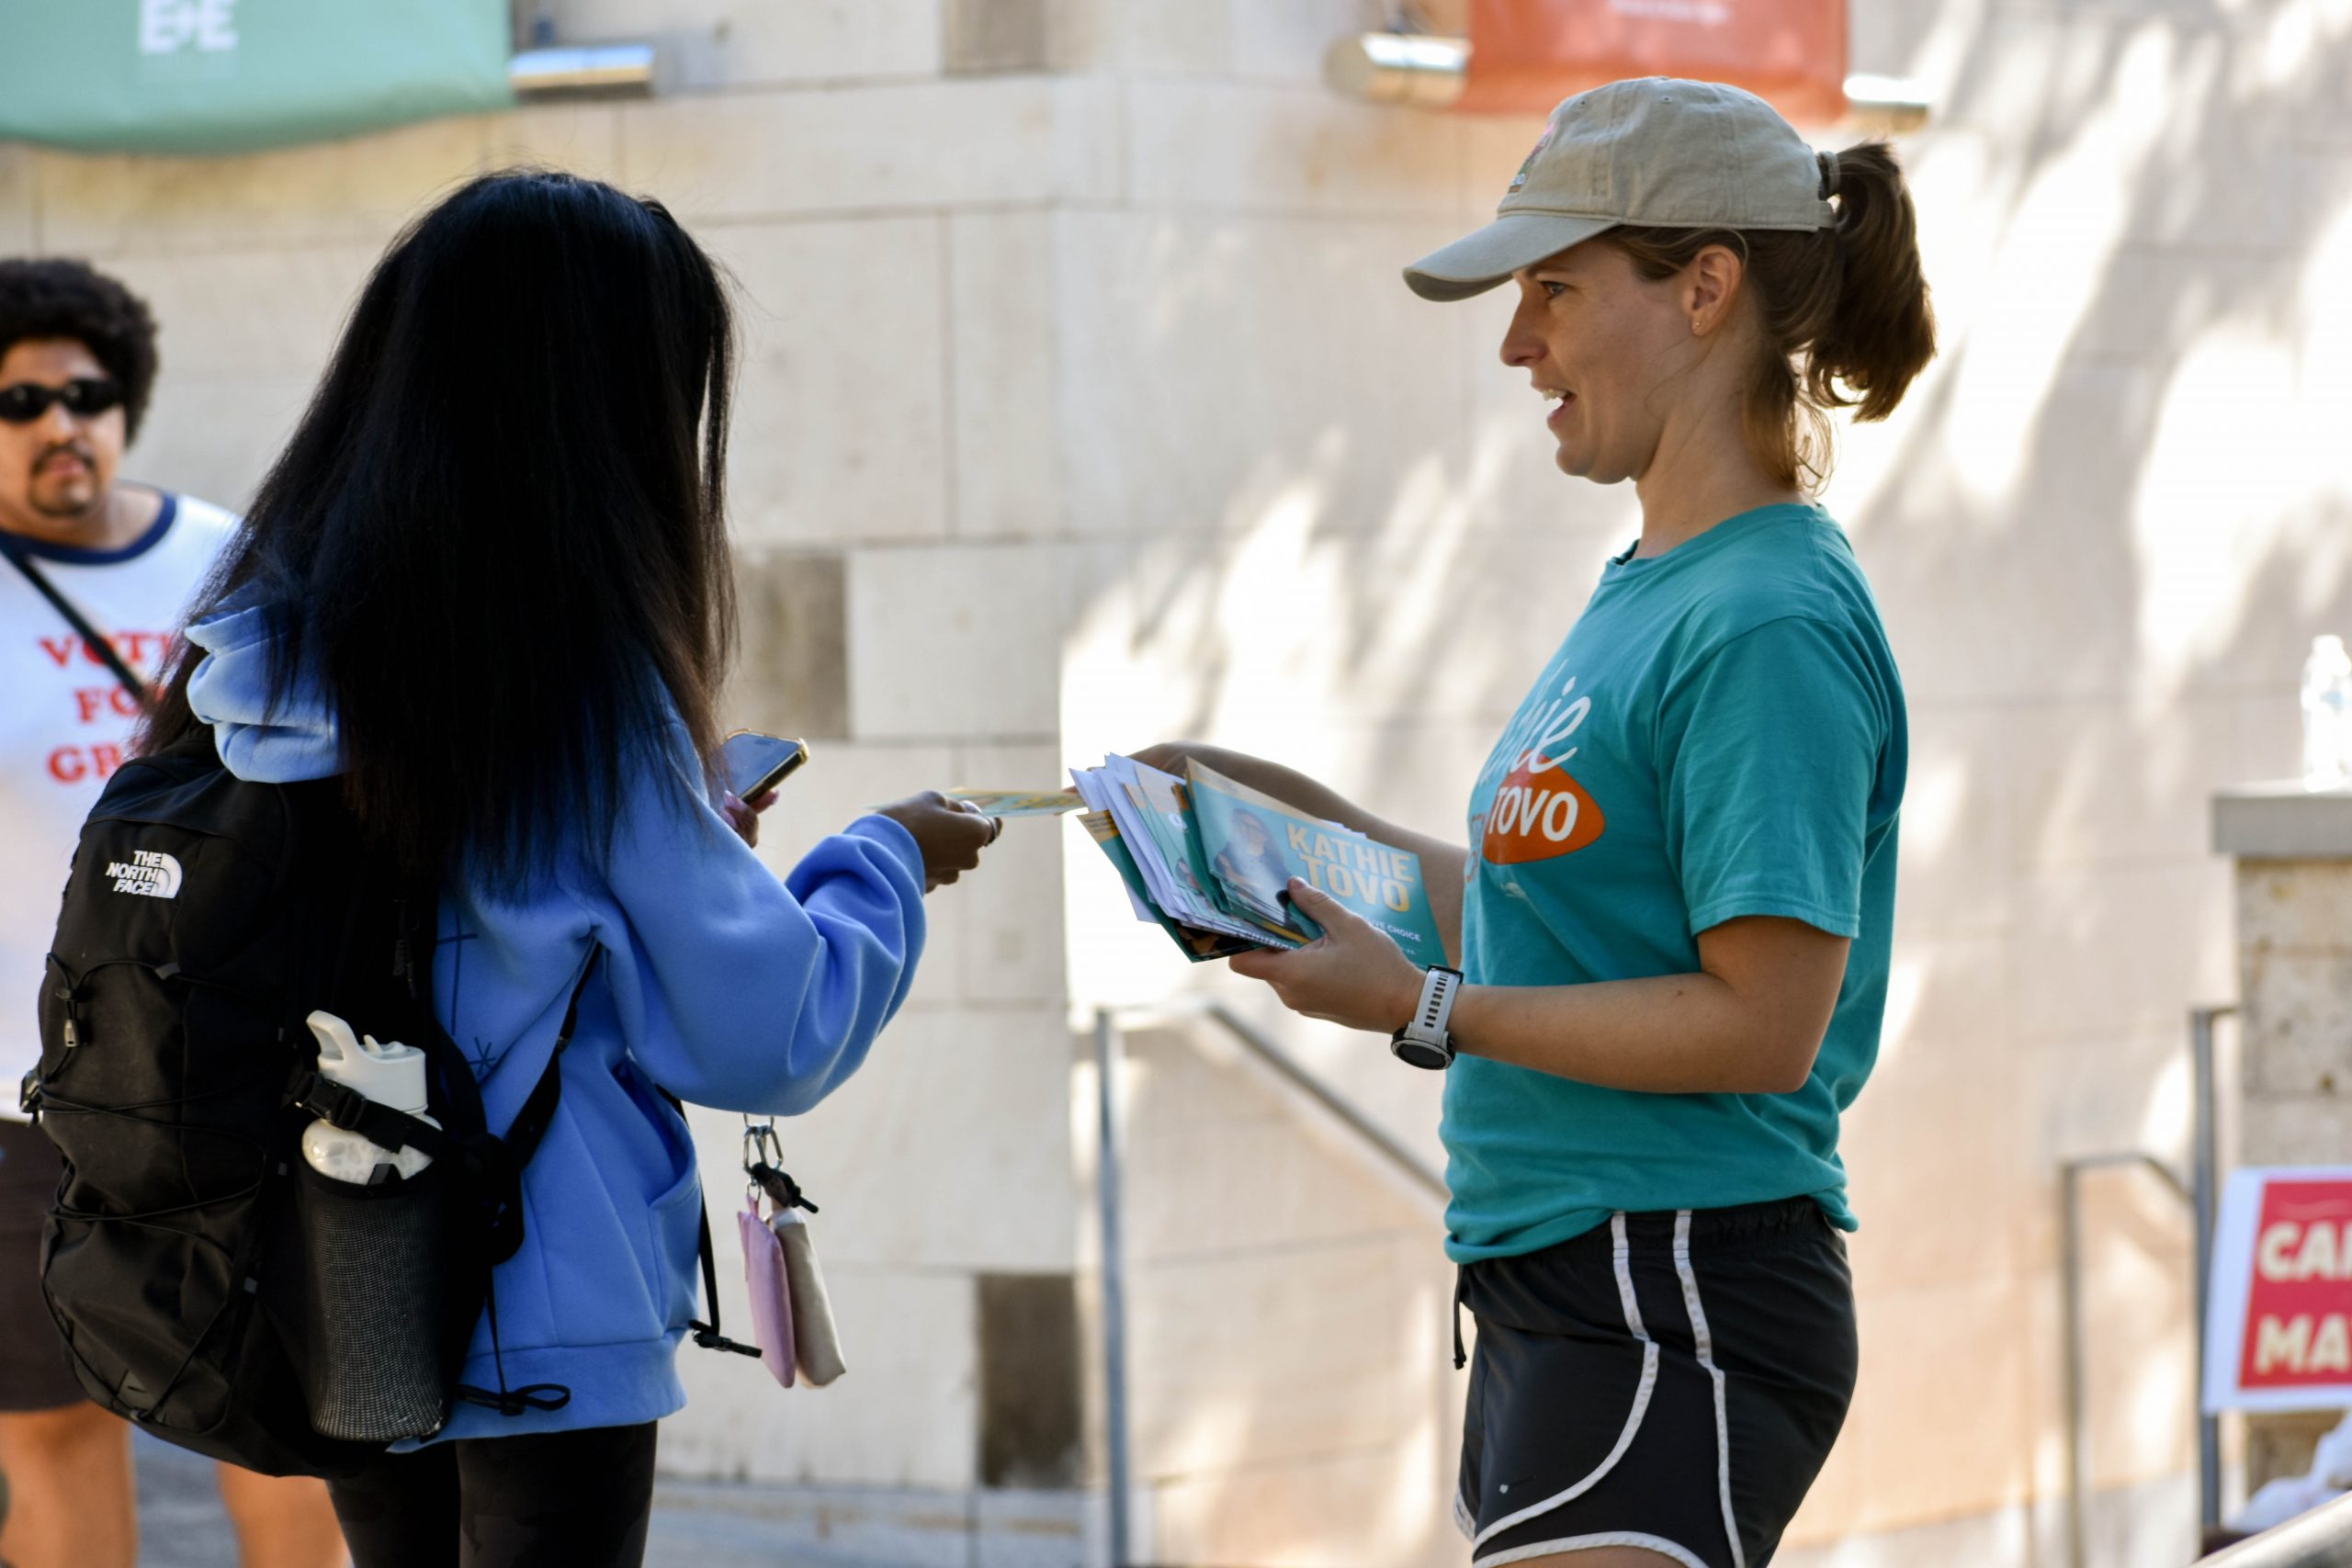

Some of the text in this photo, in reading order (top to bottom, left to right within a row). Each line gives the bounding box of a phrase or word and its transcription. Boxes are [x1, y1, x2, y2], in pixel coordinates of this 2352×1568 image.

[74, 682, 164, 724] FO
[1487, 784, 1579, 842] TOVO
[105, 862, 158, 883] NORTH
[133, 850, 163, 868] THE
[1287, 822, 1414, 884] KATHIE
[112, 878, 155, 897] FACE
[1298, 852, 1410, 913] TOVO
[1386, 924, 1422, 942] CHOICE
[2254, 1314, 2352, 1376] MA
